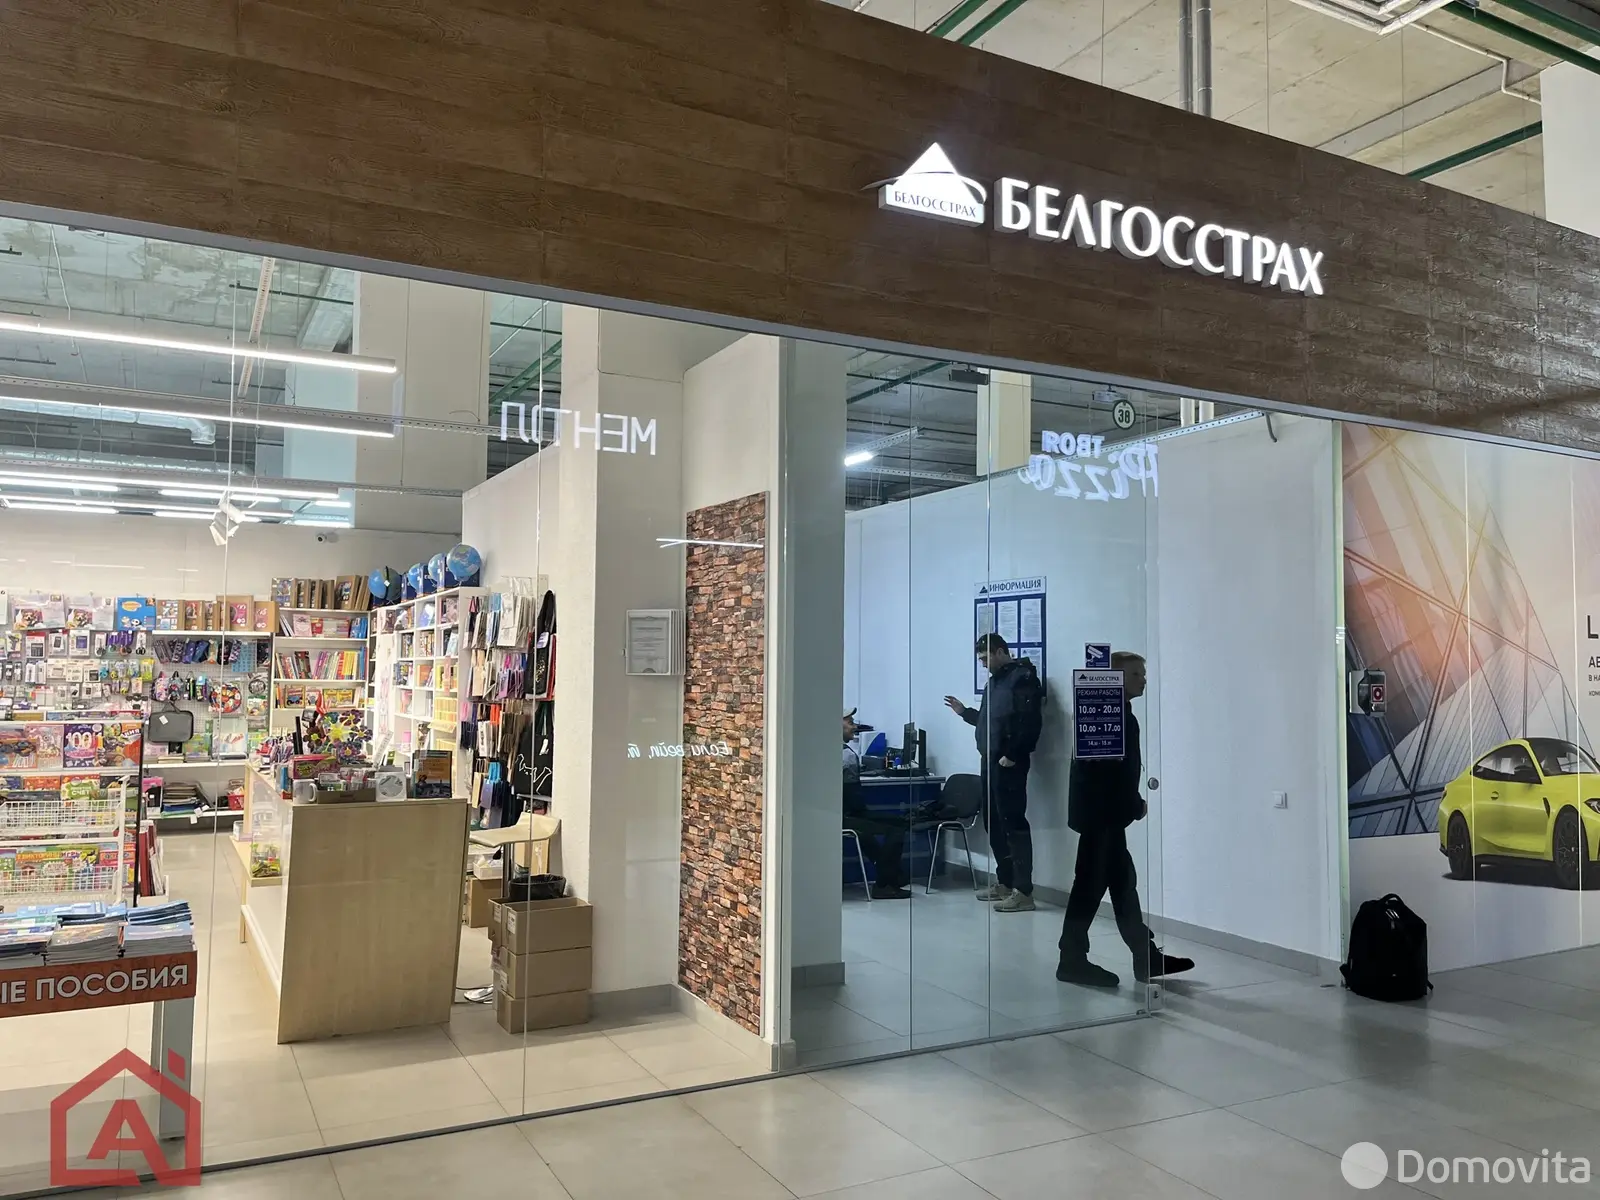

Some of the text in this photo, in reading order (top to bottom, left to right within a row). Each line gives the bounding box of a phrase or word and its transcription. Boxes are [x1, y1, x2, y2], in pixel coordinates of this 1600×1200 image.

[894, 190, 976, 219] БЕЛГОССТРАХ
[999, 176, 1325, 297] БЕЛГОССТРАХ
[1117, 408, 1131, 424] 38
[989, 579, 1042, 592] ИНФОРМАЦИЯ
[1079, 705, 1096, 714] 10.00
[1103, 705, 1120, 713] 20.00
[1079, 724, 1096, 732] 10.00
[1104, 723, 1121, 732] 17.00
[36, 964, 188, 1000] ПОСОБИЯ
